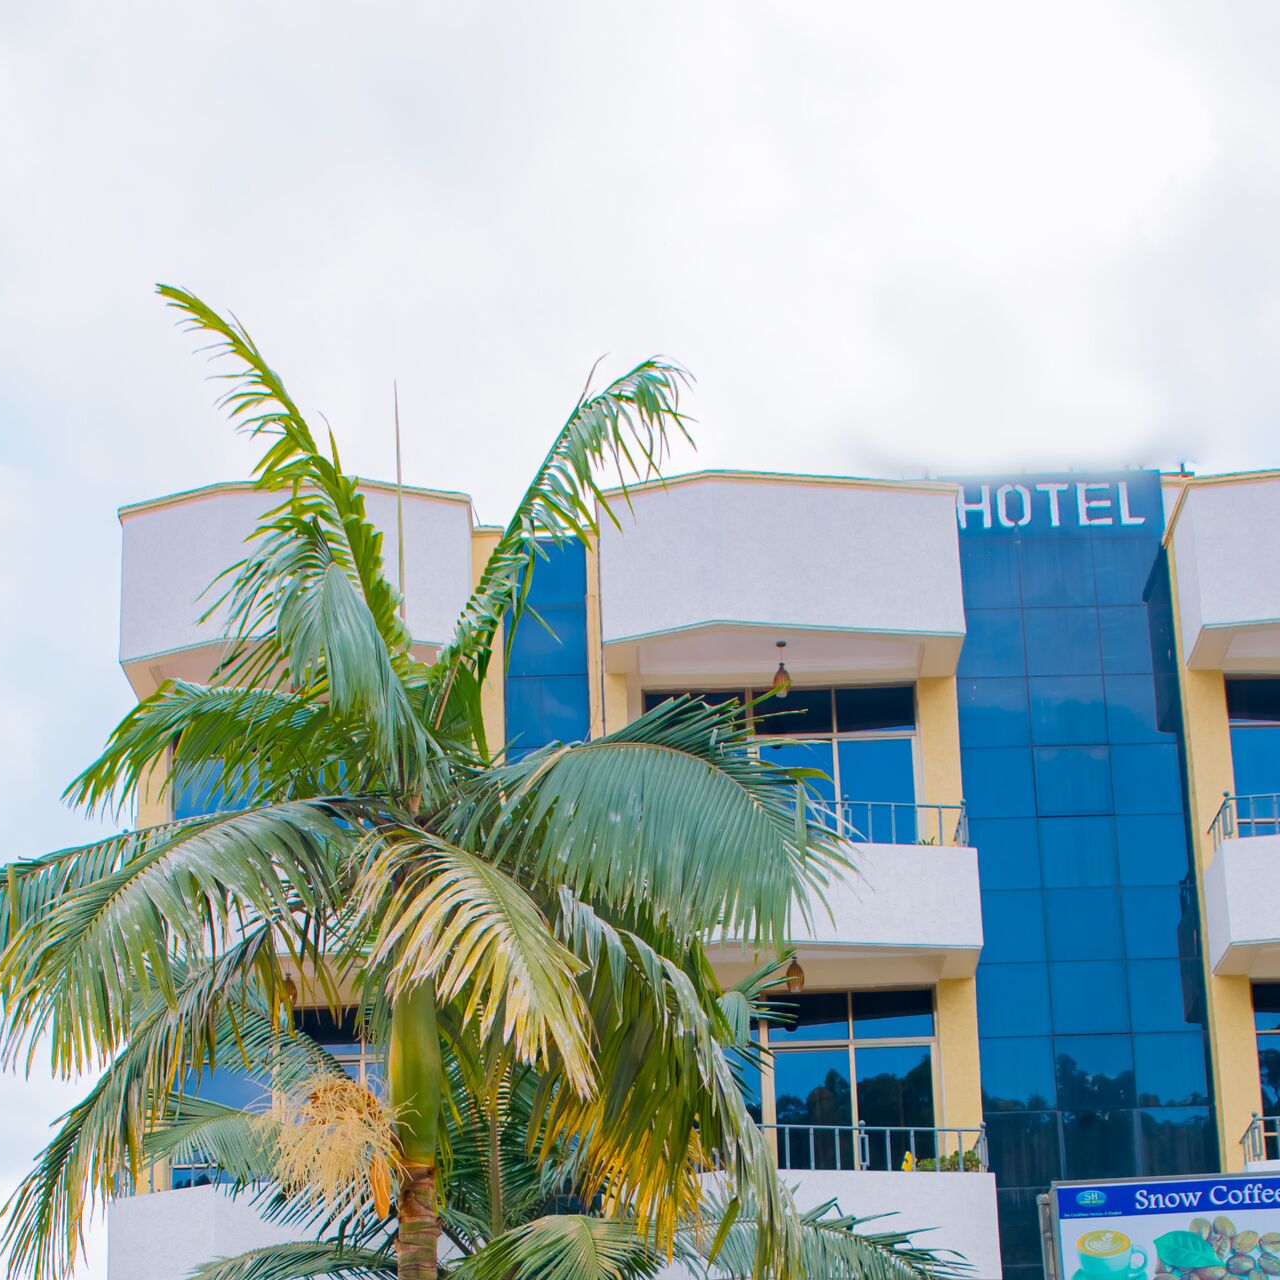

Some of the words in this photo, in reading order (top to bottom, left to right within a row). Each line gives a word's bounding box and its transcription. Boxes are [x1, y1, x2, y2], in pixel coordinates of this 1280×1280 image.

[957, 482, 1146, 529] HOTEL
[1083, 1191, 1099, 1201] SH
[1135, 1189, 1203, 1209] Snow
